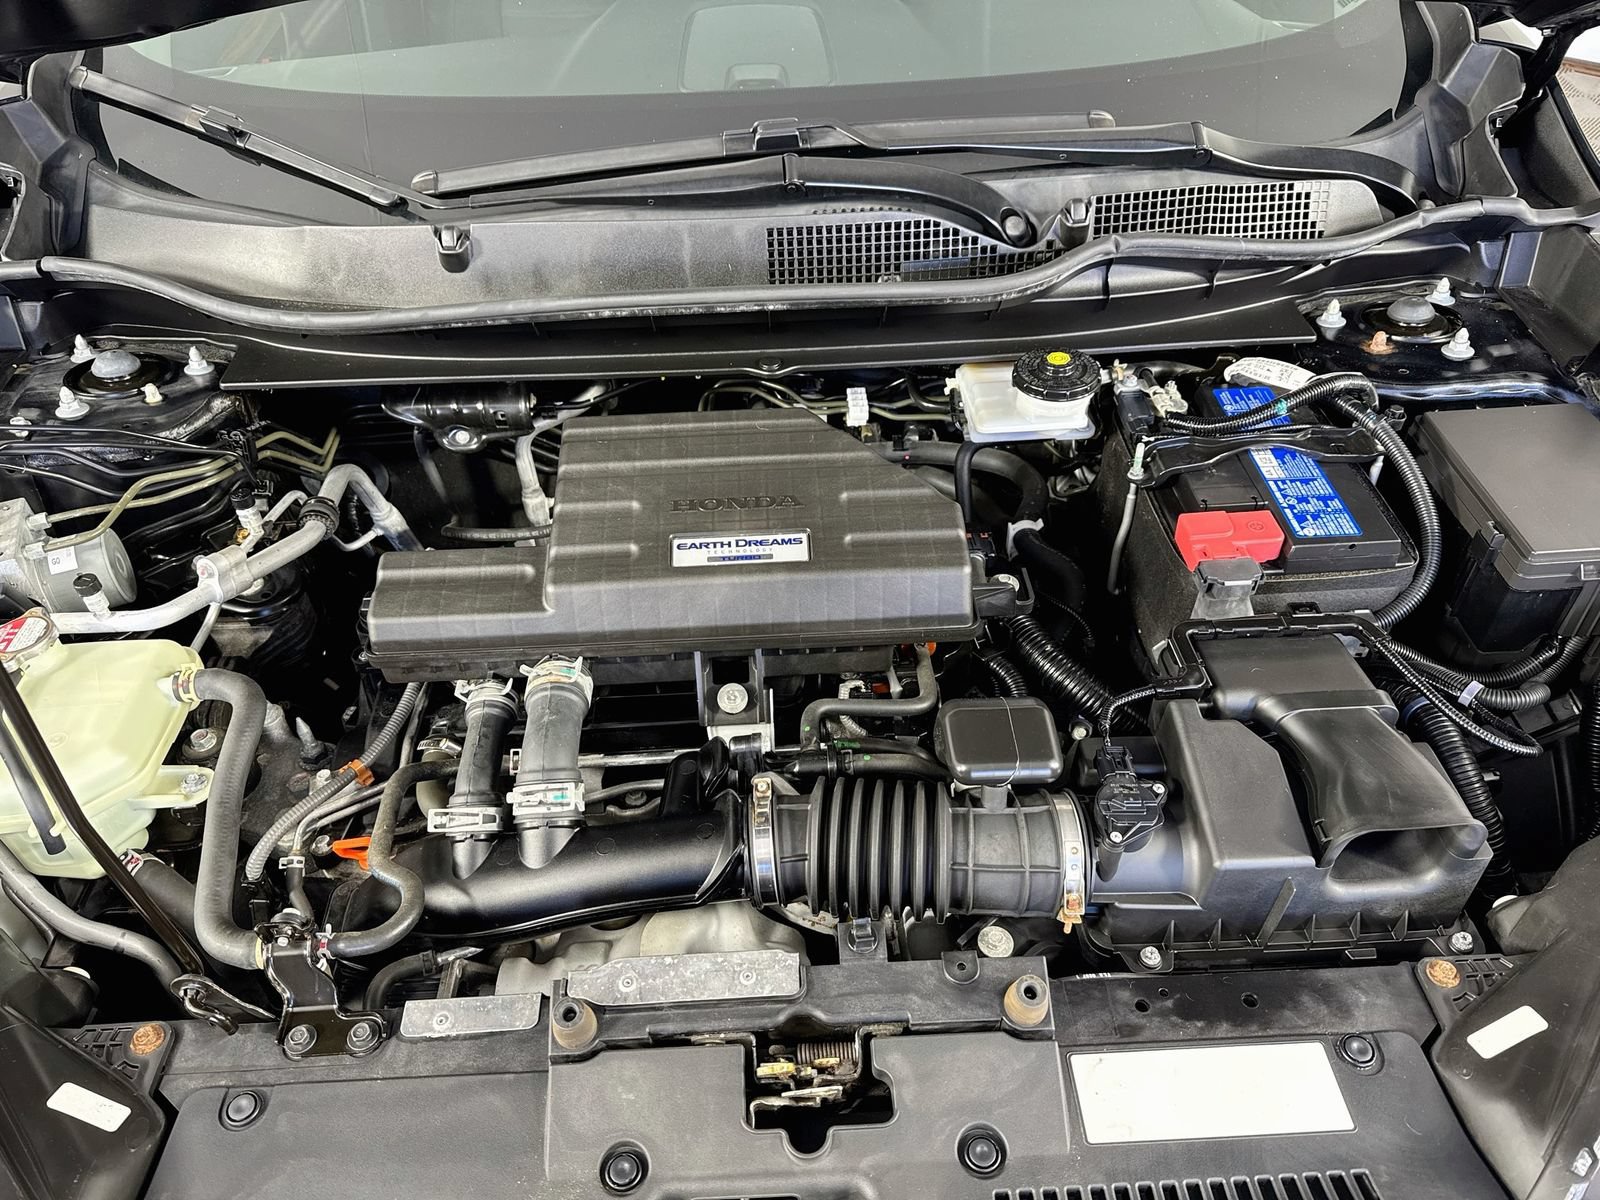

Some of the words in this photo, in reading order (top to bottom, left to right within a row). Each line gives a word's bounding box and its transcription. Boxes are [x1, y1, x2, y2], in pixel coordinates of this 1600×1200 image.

[669, 495, 805, 512] HONDA
[676, 541, 732, 550] EARTH
[735, 538, 803, 548] DREAMS
